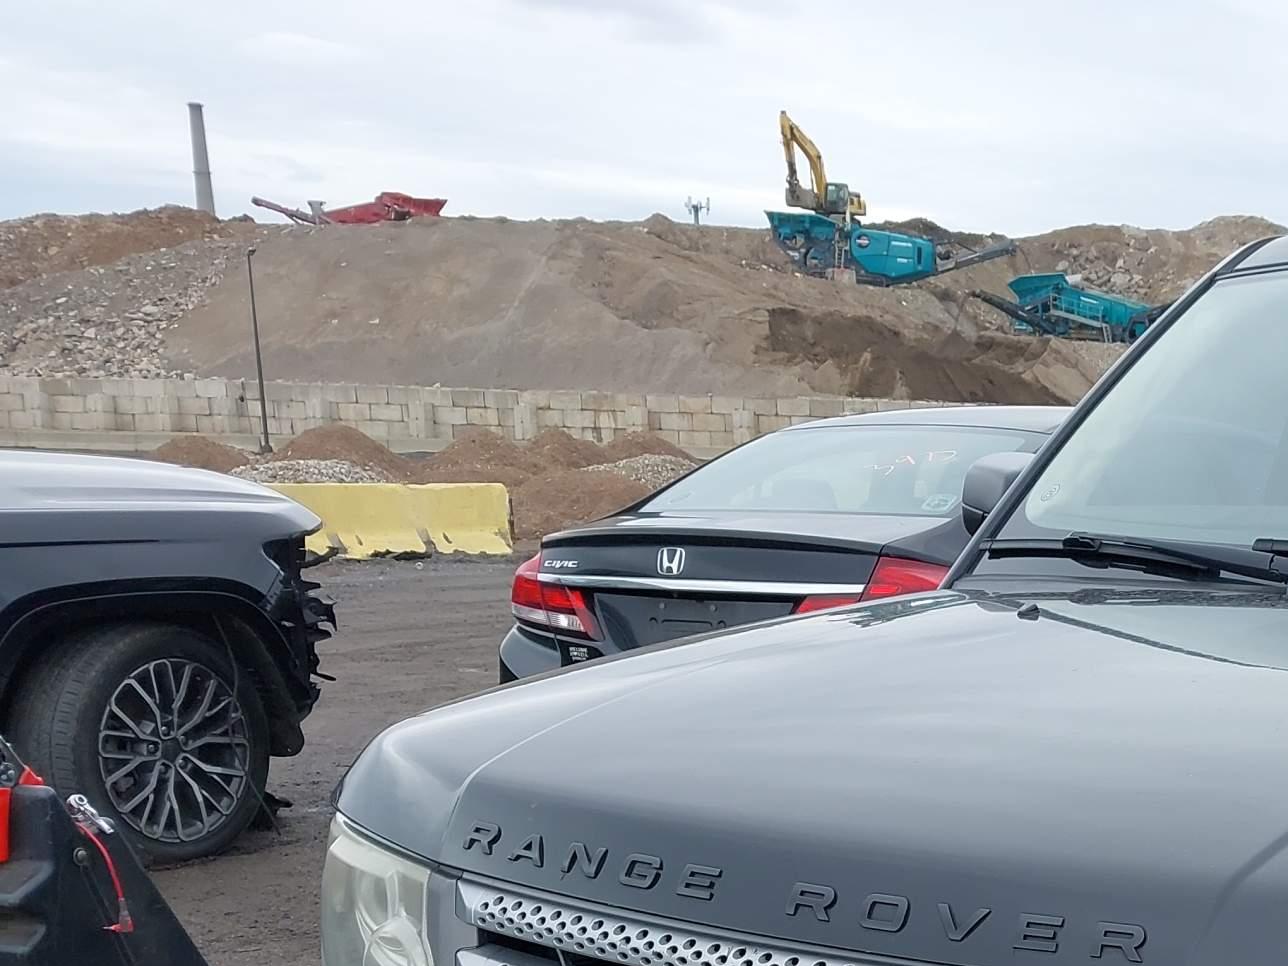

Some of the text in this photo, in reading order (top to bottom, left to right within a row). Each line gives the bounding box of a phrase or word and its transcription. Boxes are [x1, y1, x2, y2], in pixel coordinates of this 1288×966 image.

[544, 560, 579, 568] CIVIC
[462, 820, 1148, 963] RANGE ROVER
